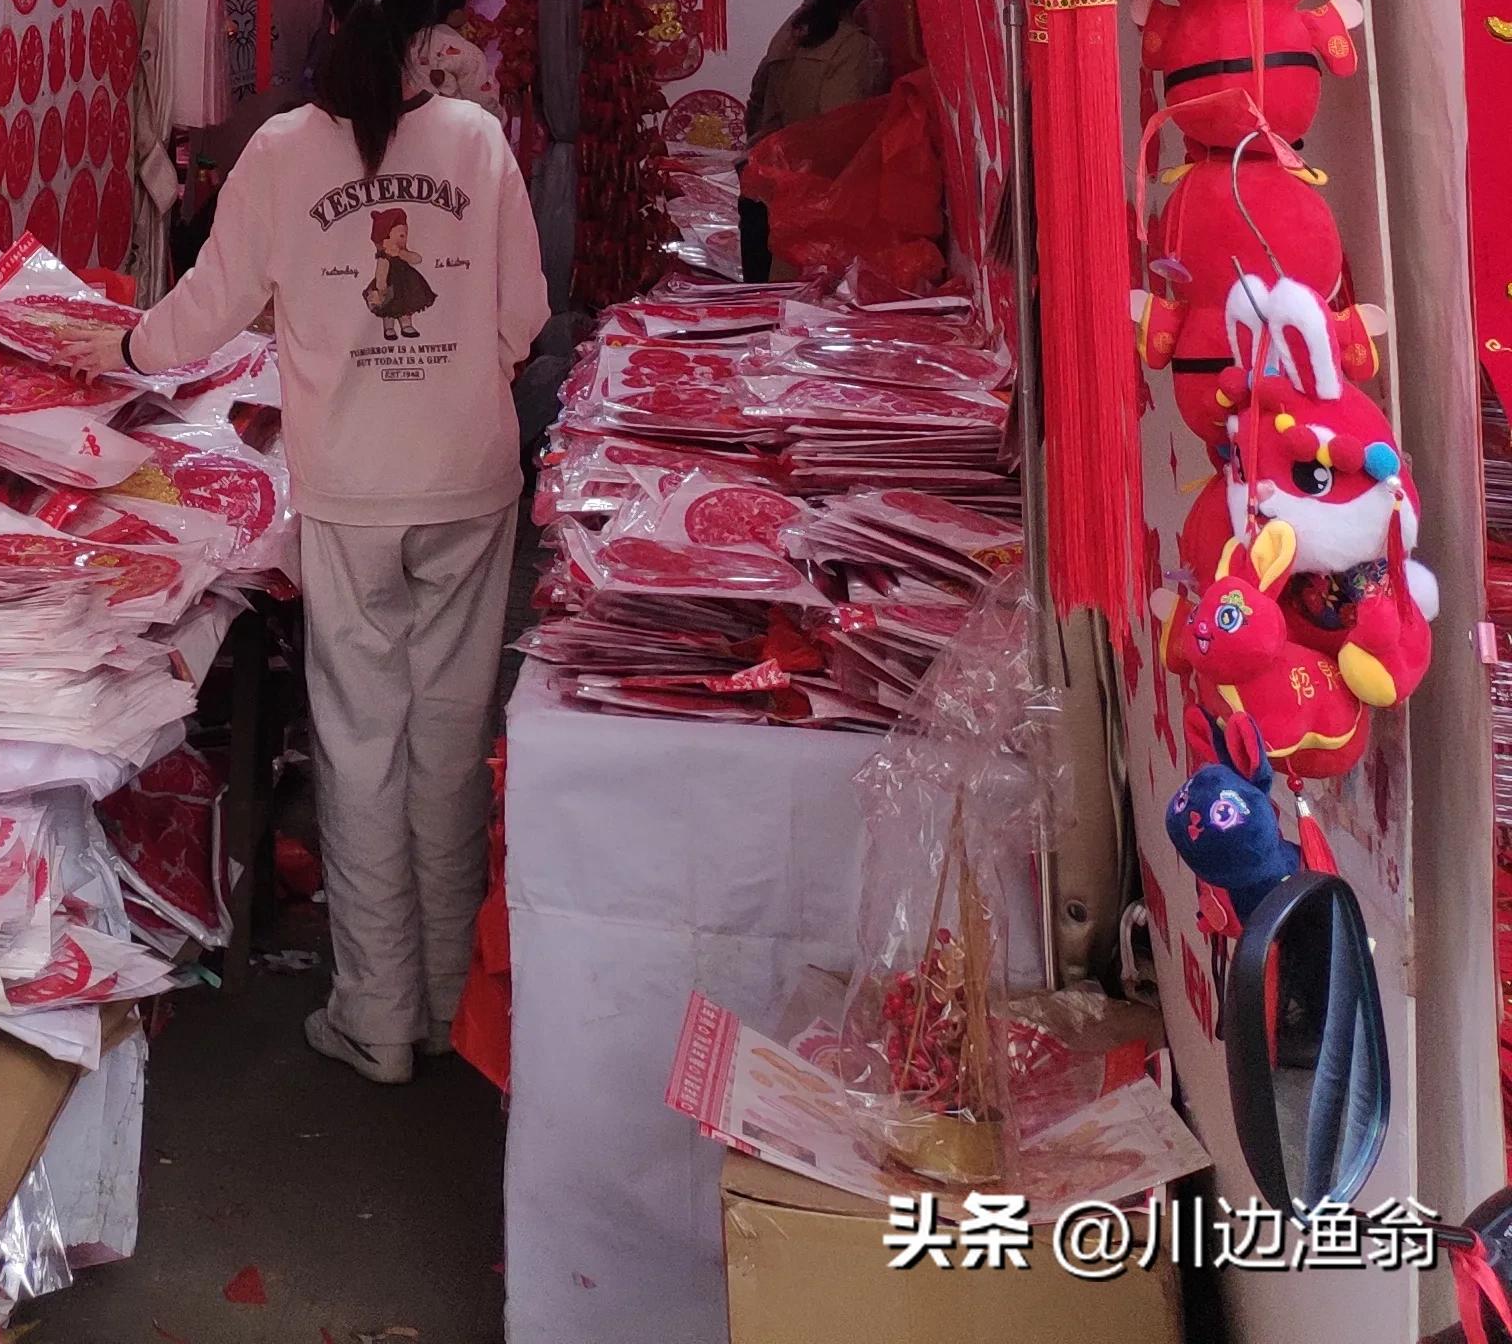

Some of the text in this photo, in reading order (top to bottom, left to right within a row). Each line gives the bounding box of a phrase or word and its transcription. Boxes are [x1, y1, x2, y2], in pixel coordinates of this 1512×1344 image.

[309, 174, 471, 232] YESTERDAY
[356, 357, 371, 368] BUT
[374, 356, 405, 366] TODAY
